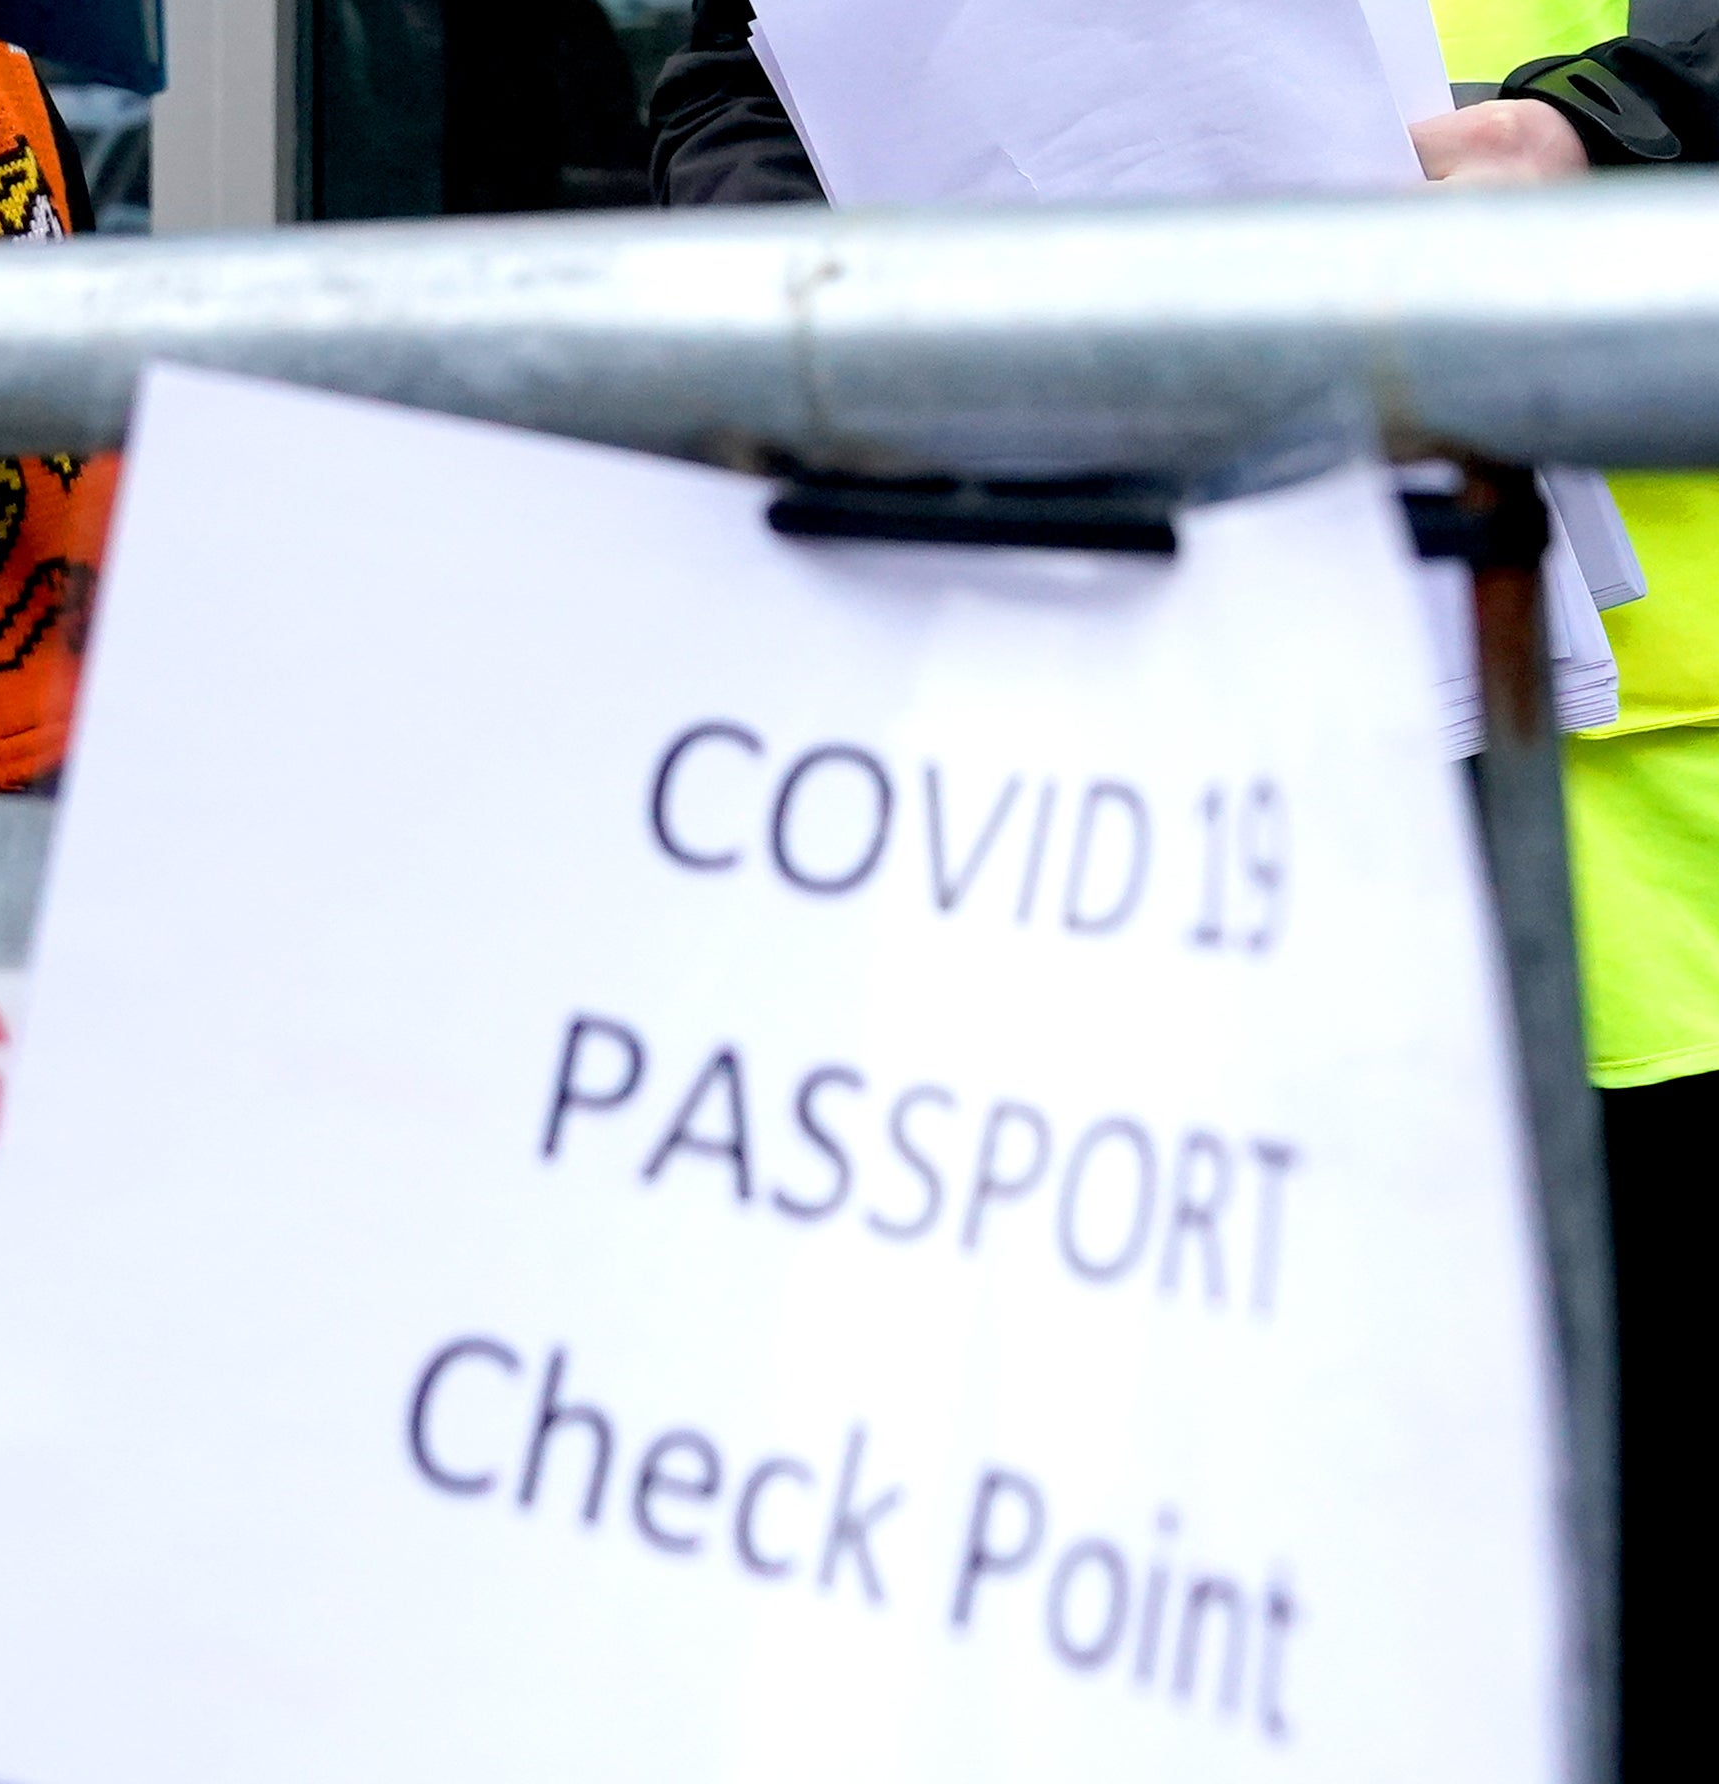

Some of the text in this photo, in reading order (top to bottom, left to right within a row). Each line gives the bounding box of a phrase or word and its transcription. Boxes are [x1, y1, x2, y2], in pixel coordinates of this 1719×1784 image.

[647, 717, 1292, 954] COVID 19
[540, 1012, 1298, 1319] PASSPORT
[405, 1333, 1295, 1742] Check Point
